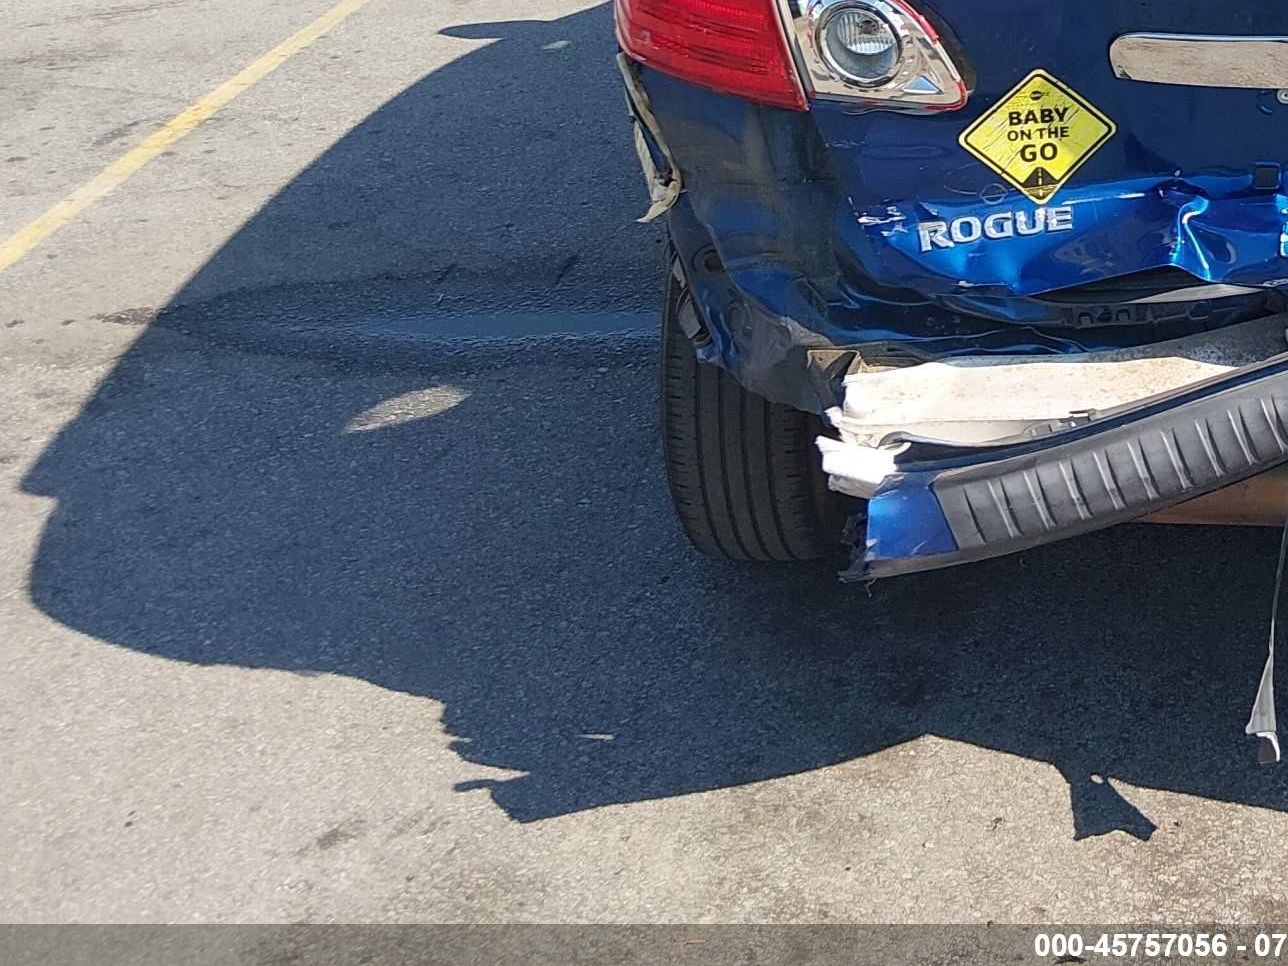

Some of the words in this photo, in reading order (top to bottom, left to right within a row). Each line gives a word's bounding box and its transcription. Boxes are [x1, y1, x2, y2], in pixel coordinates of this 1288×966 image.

[1008, 107, 1069, 126] BABY
[1007, 128, 1032, 141] ON
[1036, 126, 1070, 139] THE
[1020, 142, 1058, 162] GO
[918, 206, 1074, 252] ROGUE
